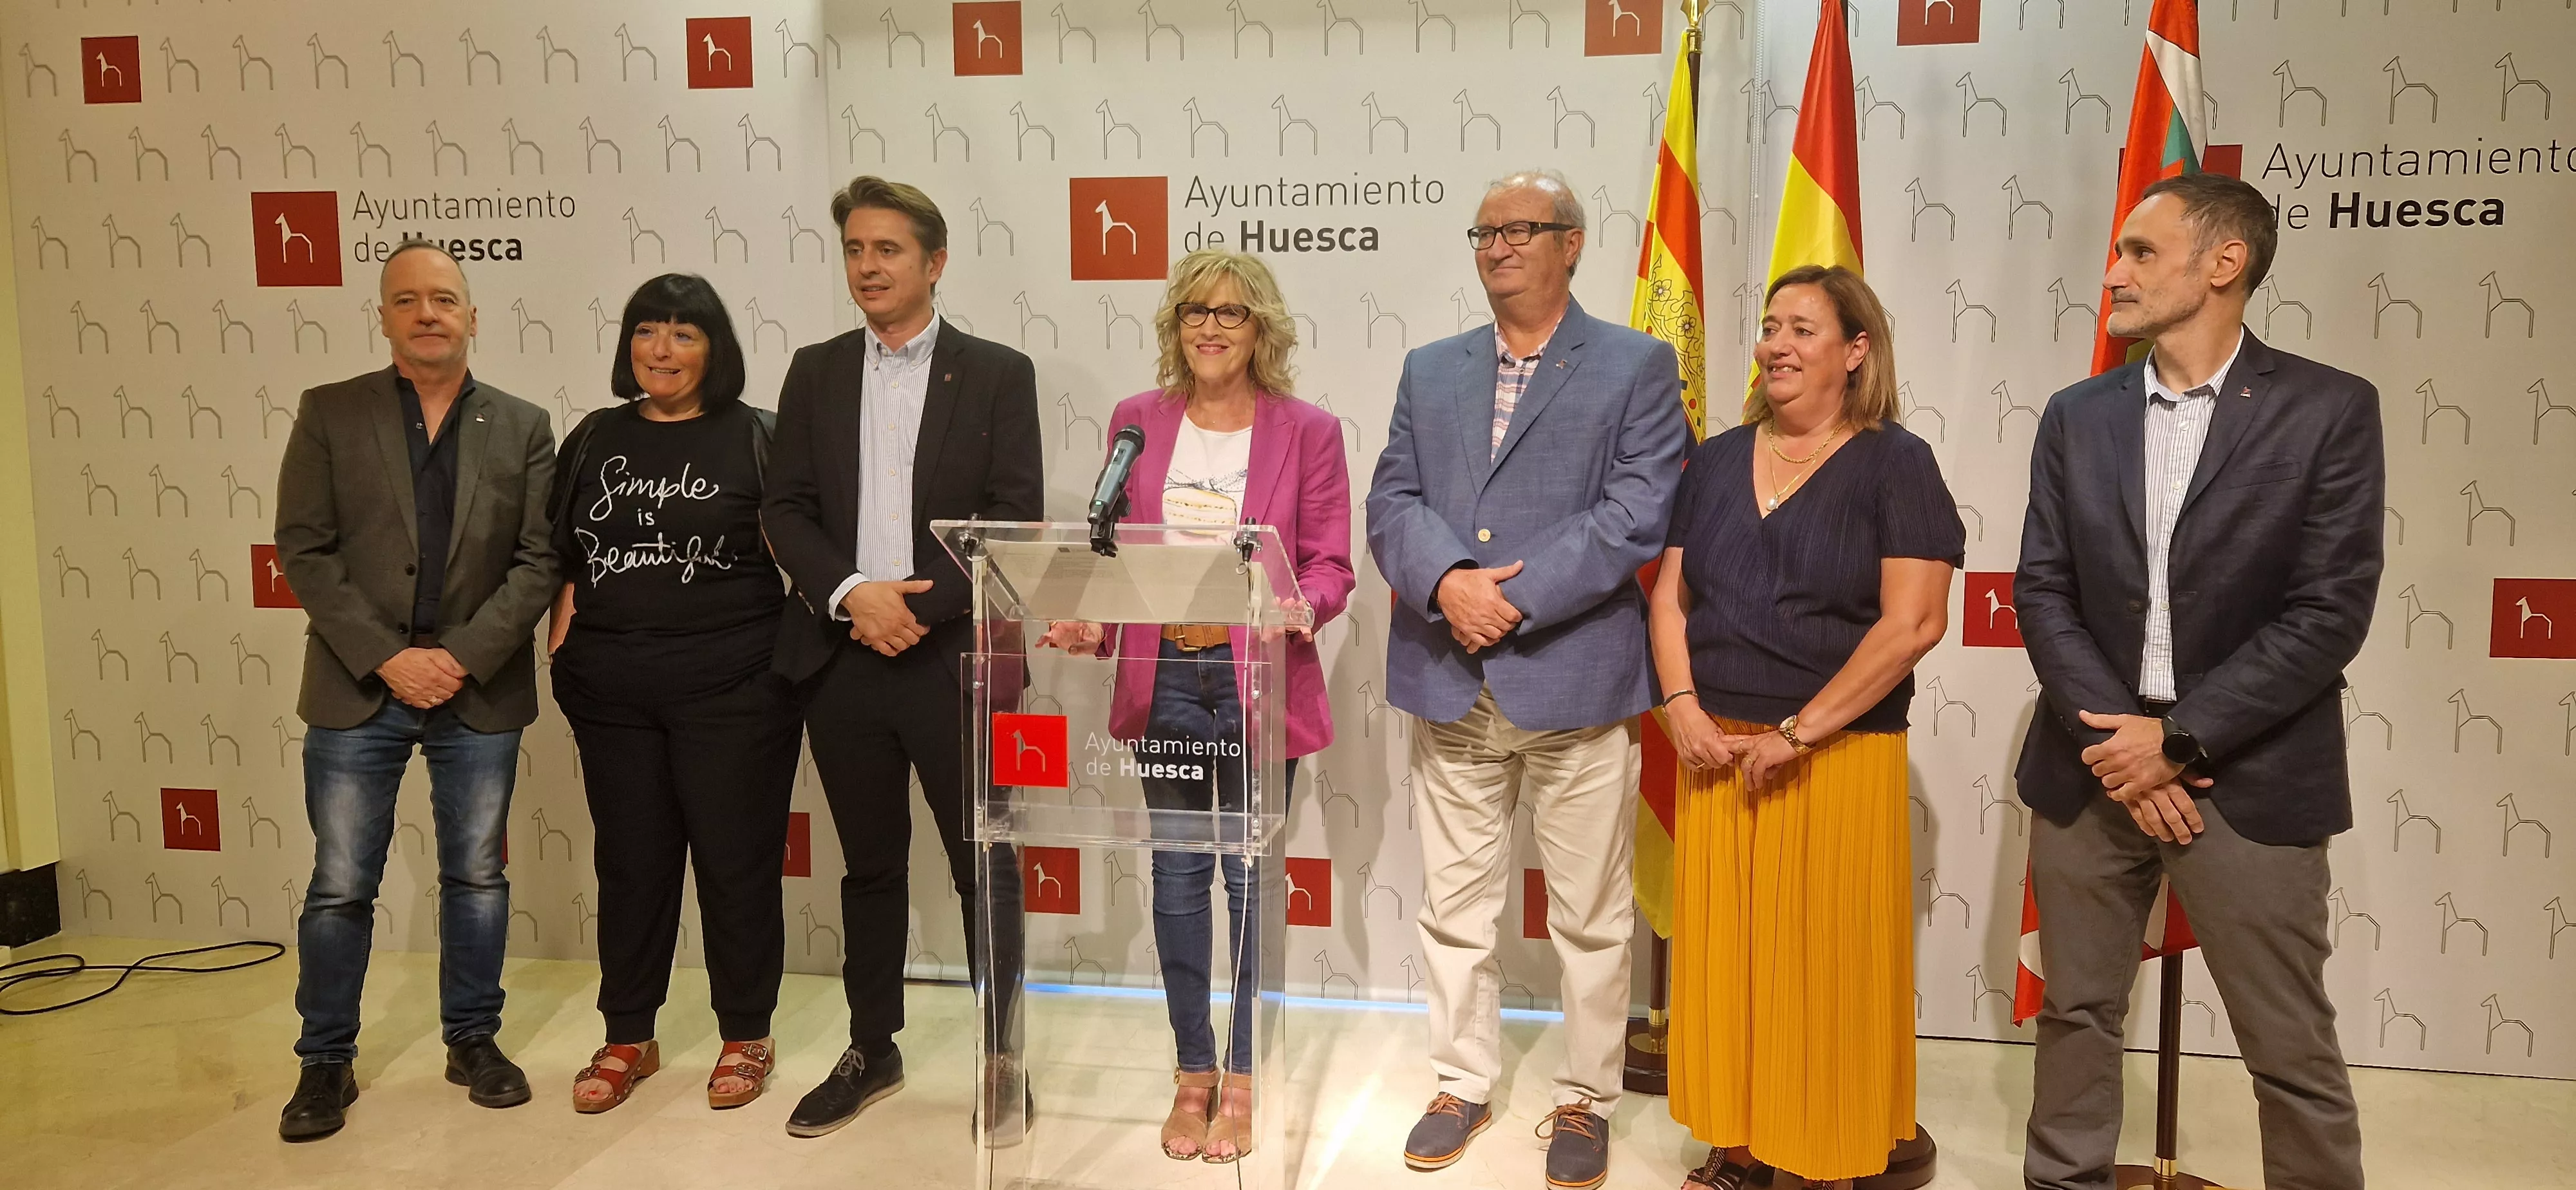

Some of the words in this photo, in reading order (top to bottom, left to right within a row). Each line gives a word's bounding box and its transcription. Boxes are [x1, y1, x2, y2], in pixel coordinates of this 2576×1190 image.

[352, 187, 575, 229] Ayuntamiento
[1184, 172, 1444, 218] Ayuntamiento
[2329, 191, 2505, 229] Huesca
[354, 231, 390, 263] de
[402, 231, 523, 261] esca
[1184, 221, 1225, 254] de
[1240, 220, 1379, 253] Huesca
[589, 455, 720, 522] Simple
[637, 507, 655, 526] is
[1084, 732, 1241, 758] Ayuntamiento
[1086, 757, 1111, 776] de
[1120, 757, 1204, 781] Huesca
